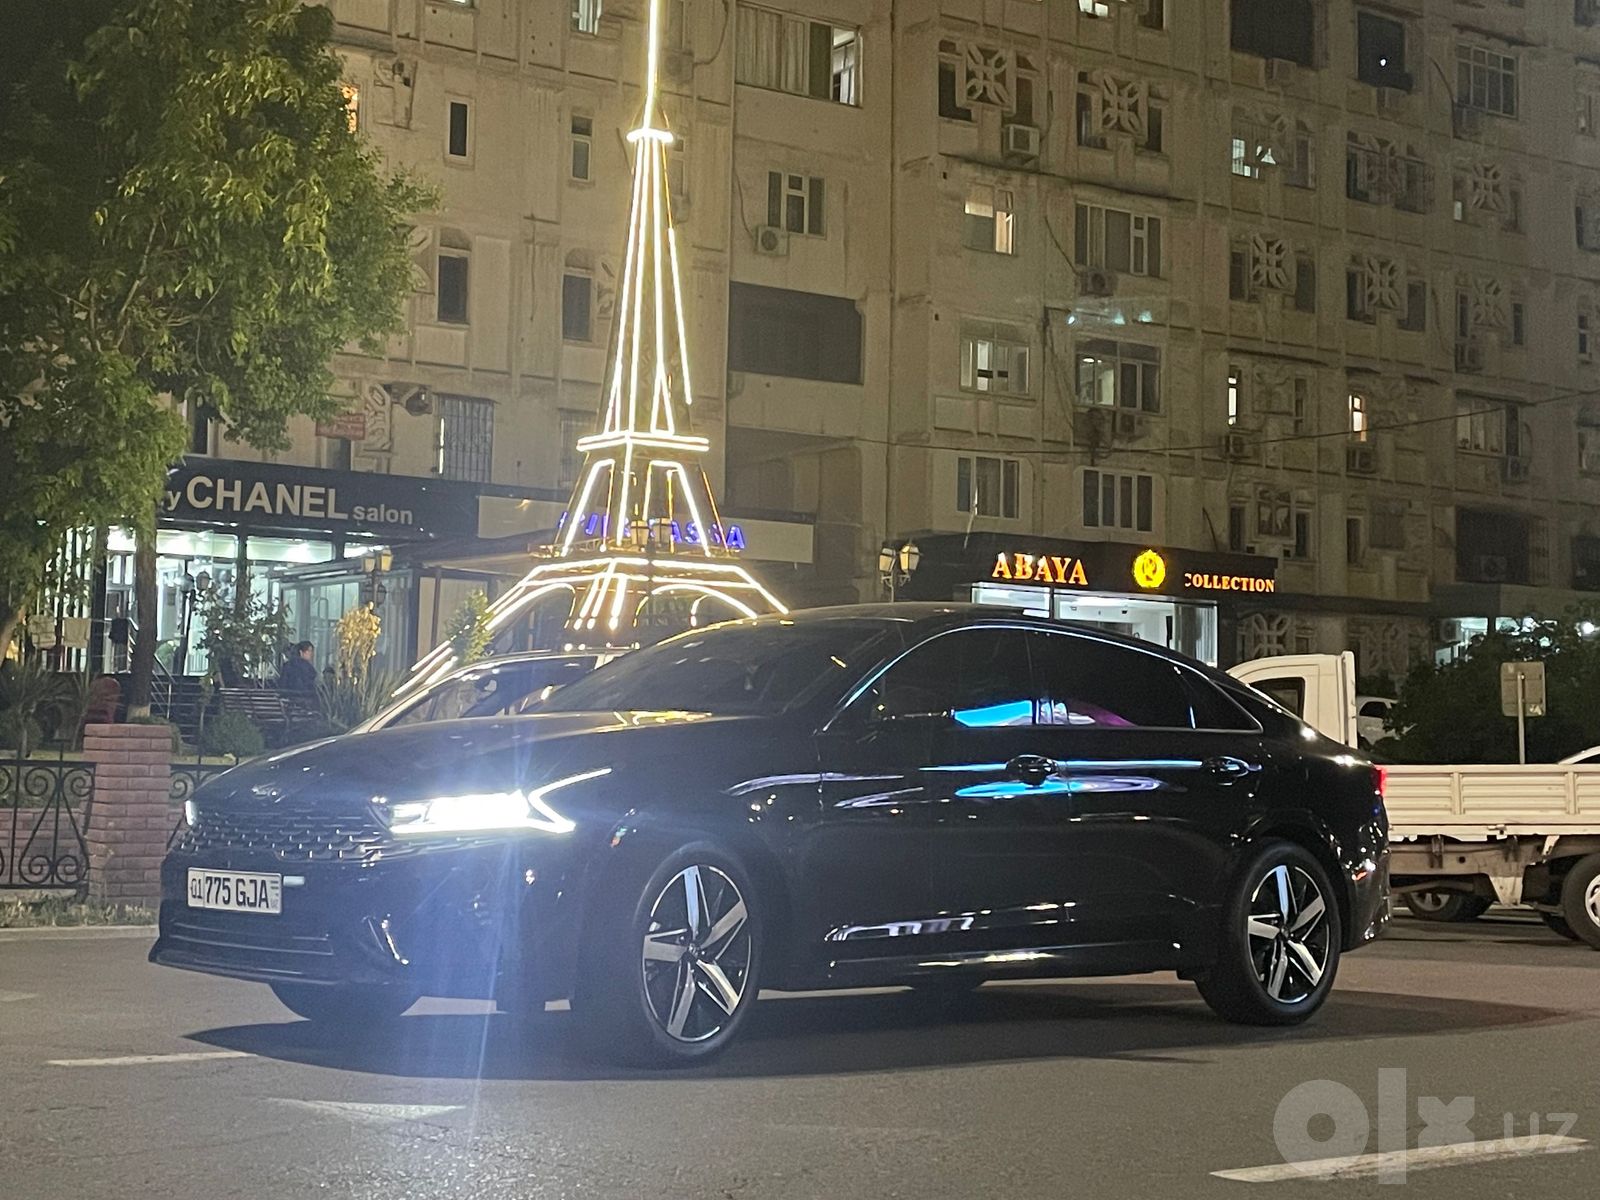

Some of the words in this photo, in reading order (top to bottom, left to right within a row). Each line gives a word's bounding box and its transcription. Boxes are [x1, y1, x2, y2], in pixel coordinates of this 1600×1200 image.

[162, 490, 182, 511] y
[186, 475, 349, 520] CHANEL
[352, 503, 413, 525] salon
[991, 552, 1088, 585] ABAYA
[205, 876, 231, 905] 775
[235, 878, 269, 908] GJA
